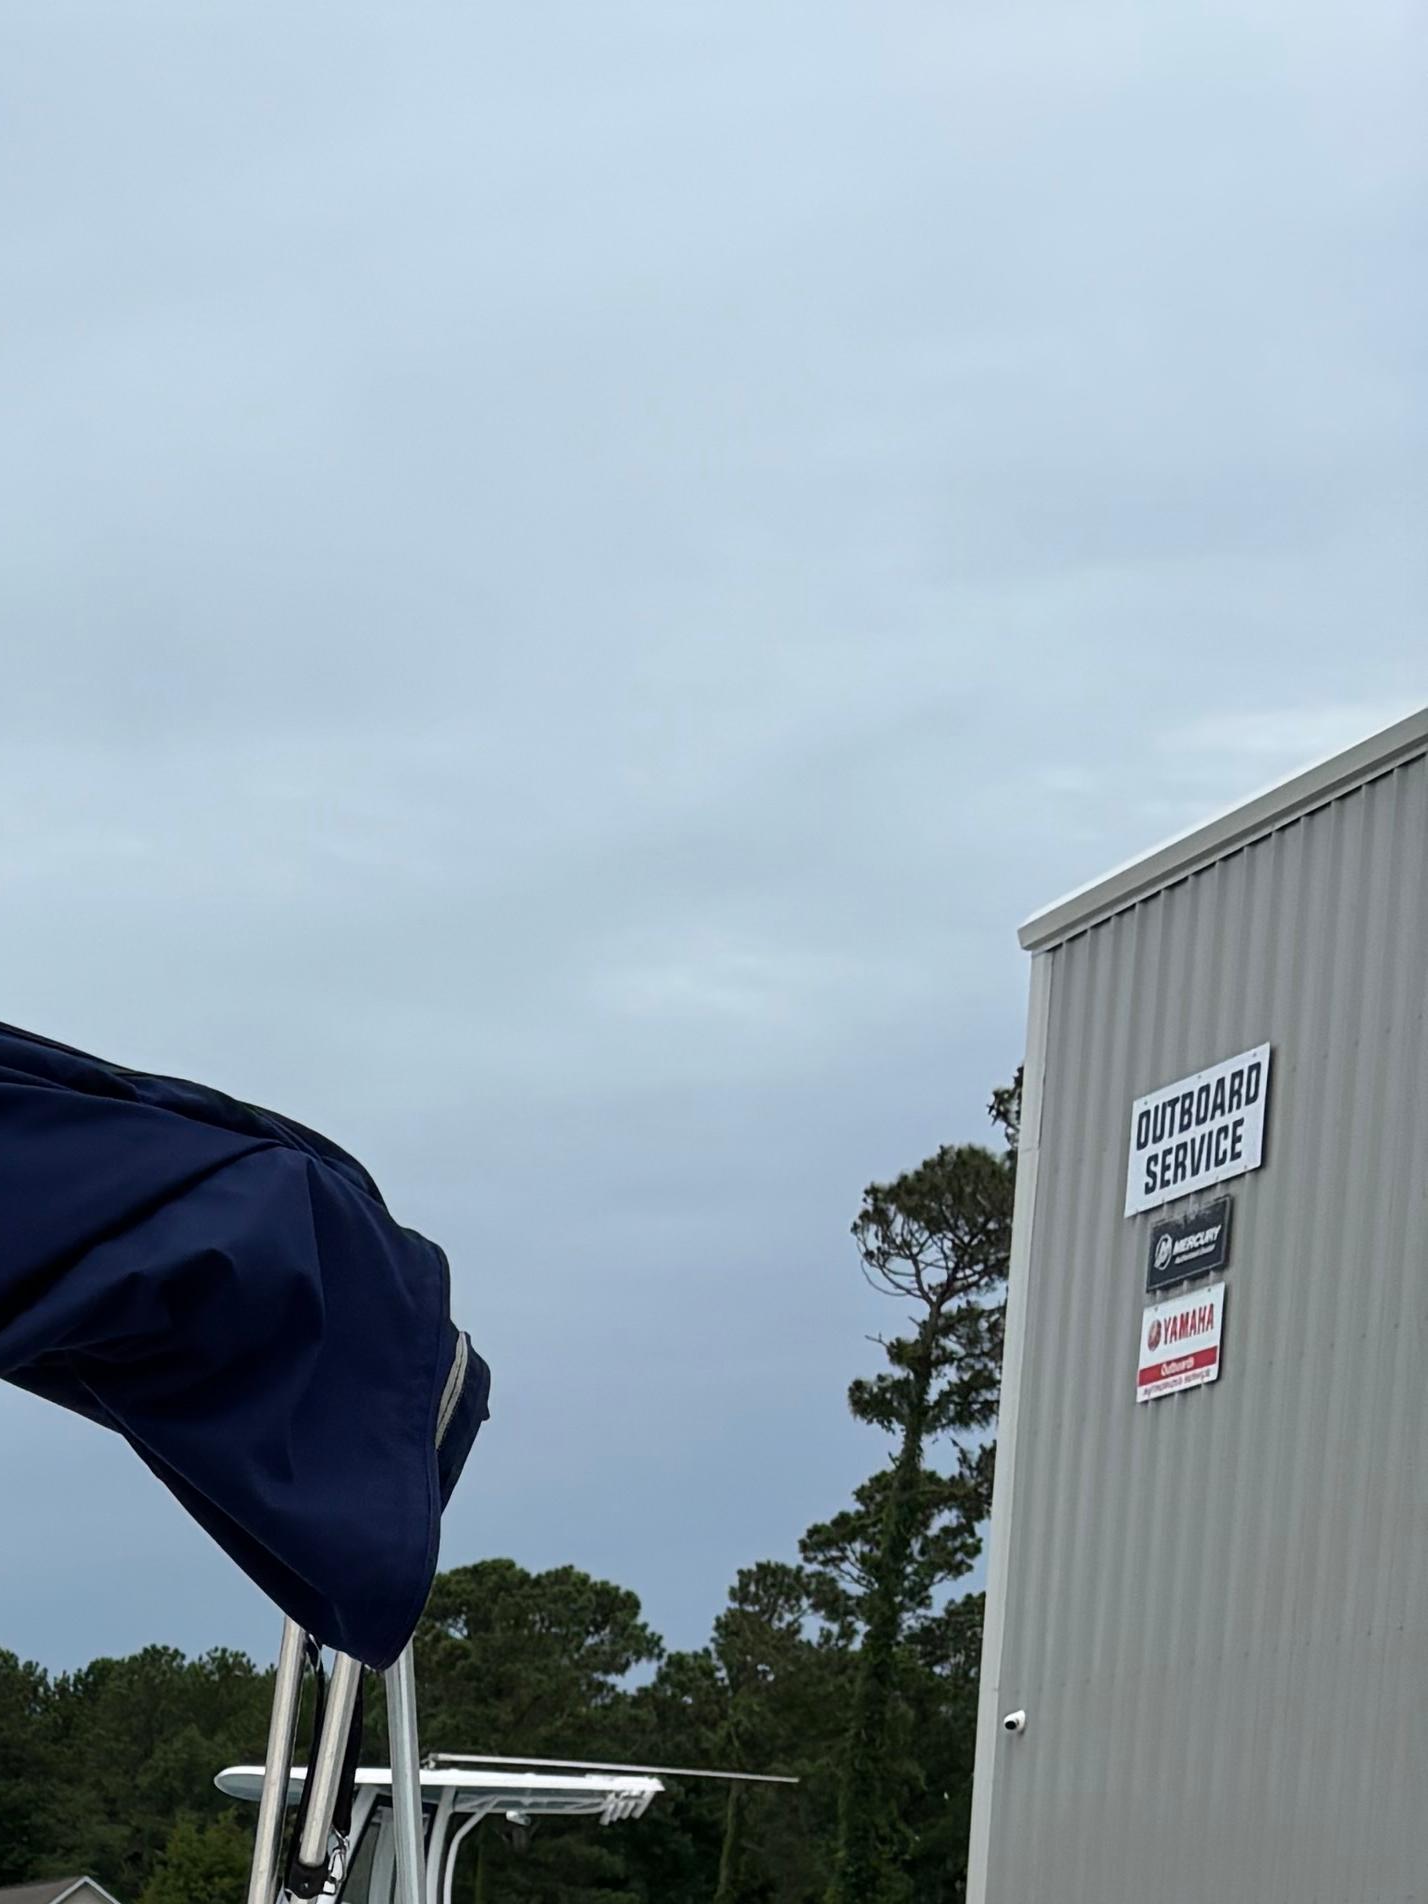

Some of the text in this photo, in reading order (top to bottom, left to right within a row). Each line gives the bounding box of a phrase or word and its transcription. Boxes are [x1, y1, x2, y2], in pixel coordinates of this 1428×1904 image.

[1136, 1061, 1262, 1151] OUTBOARD
[1144, 1117, 1245, 1196] SERVICE
[1163, 1302, 1215, 1345] YAMAHA
